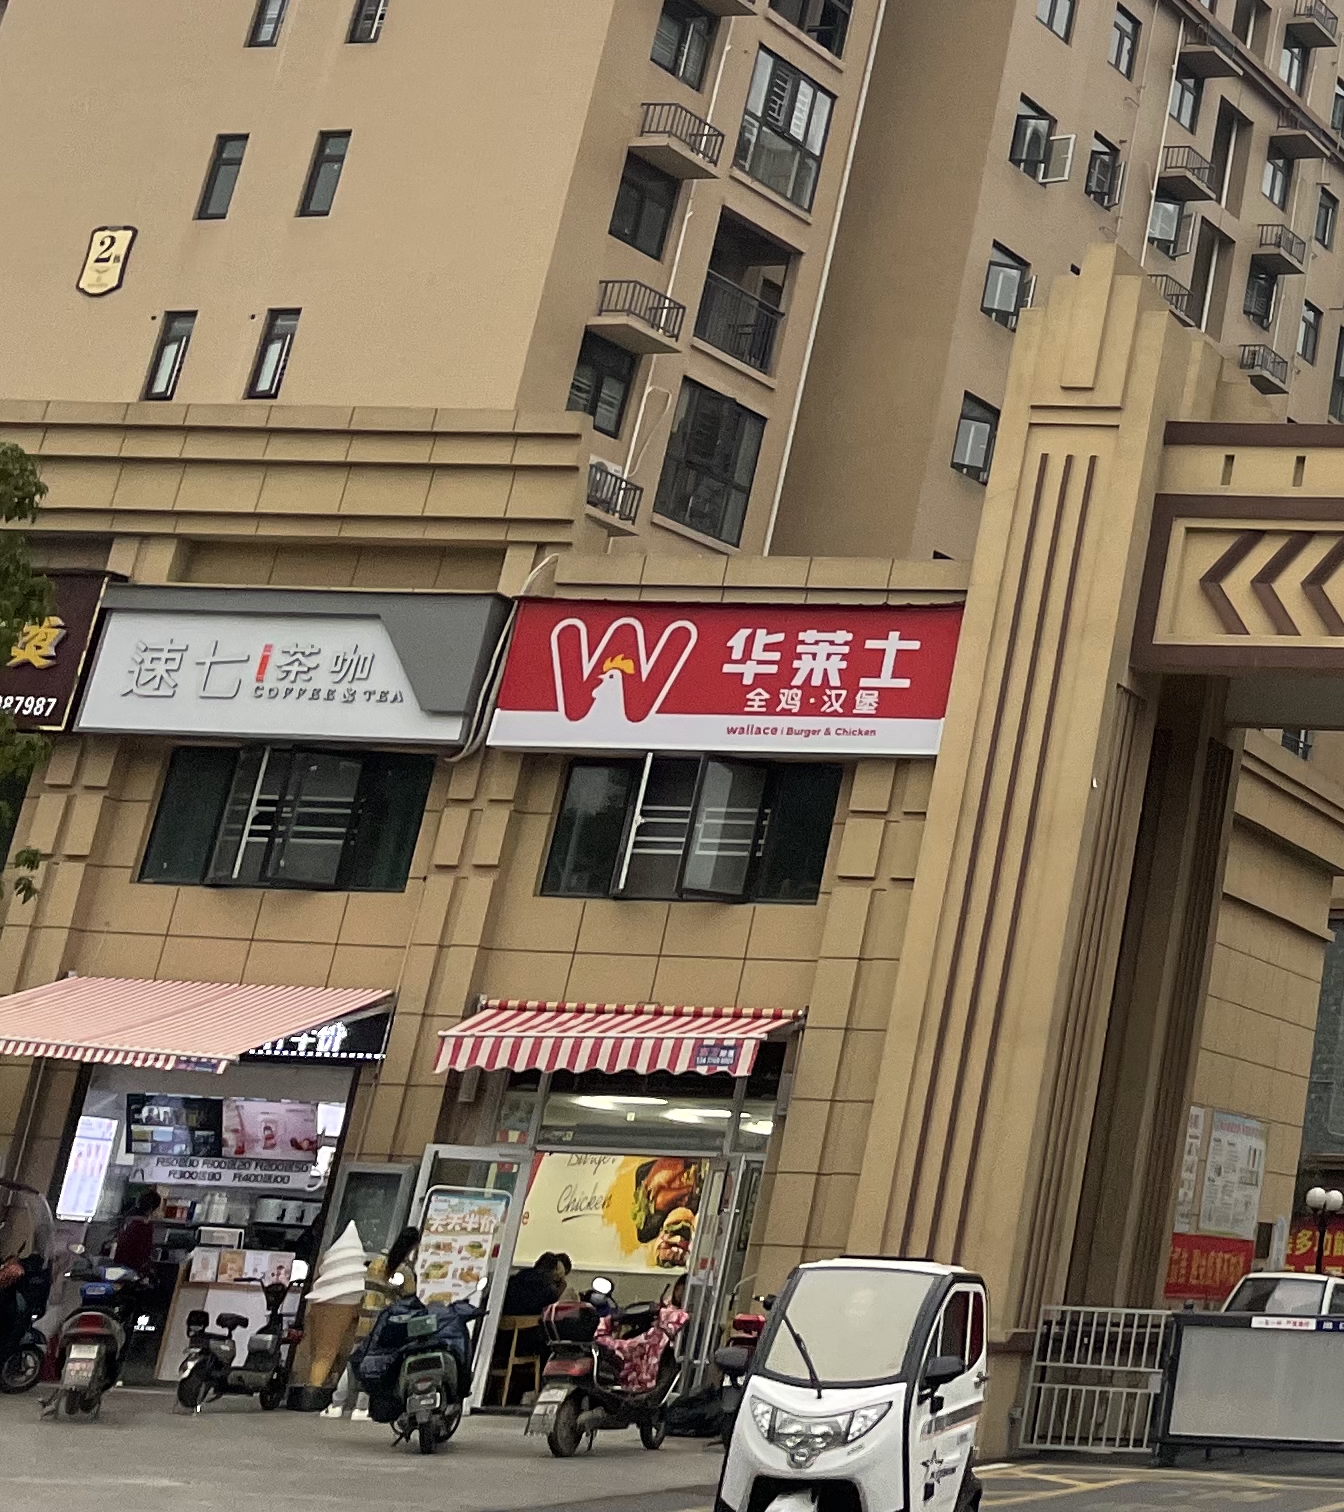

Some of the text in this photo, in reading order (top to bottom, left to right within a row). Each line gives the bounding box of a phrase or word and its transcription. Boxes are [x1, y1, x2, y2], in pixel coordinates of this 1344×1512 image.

[721, 627, 922, 689] 华莱士
[0, 695, 57, 717] 87987
[726, 723, 778, 736] wallace
[786, 726, 822, 738] Burger
[835, 727, 877, 737] Chicken
[556, 1184, 613, 1214] Chicken
